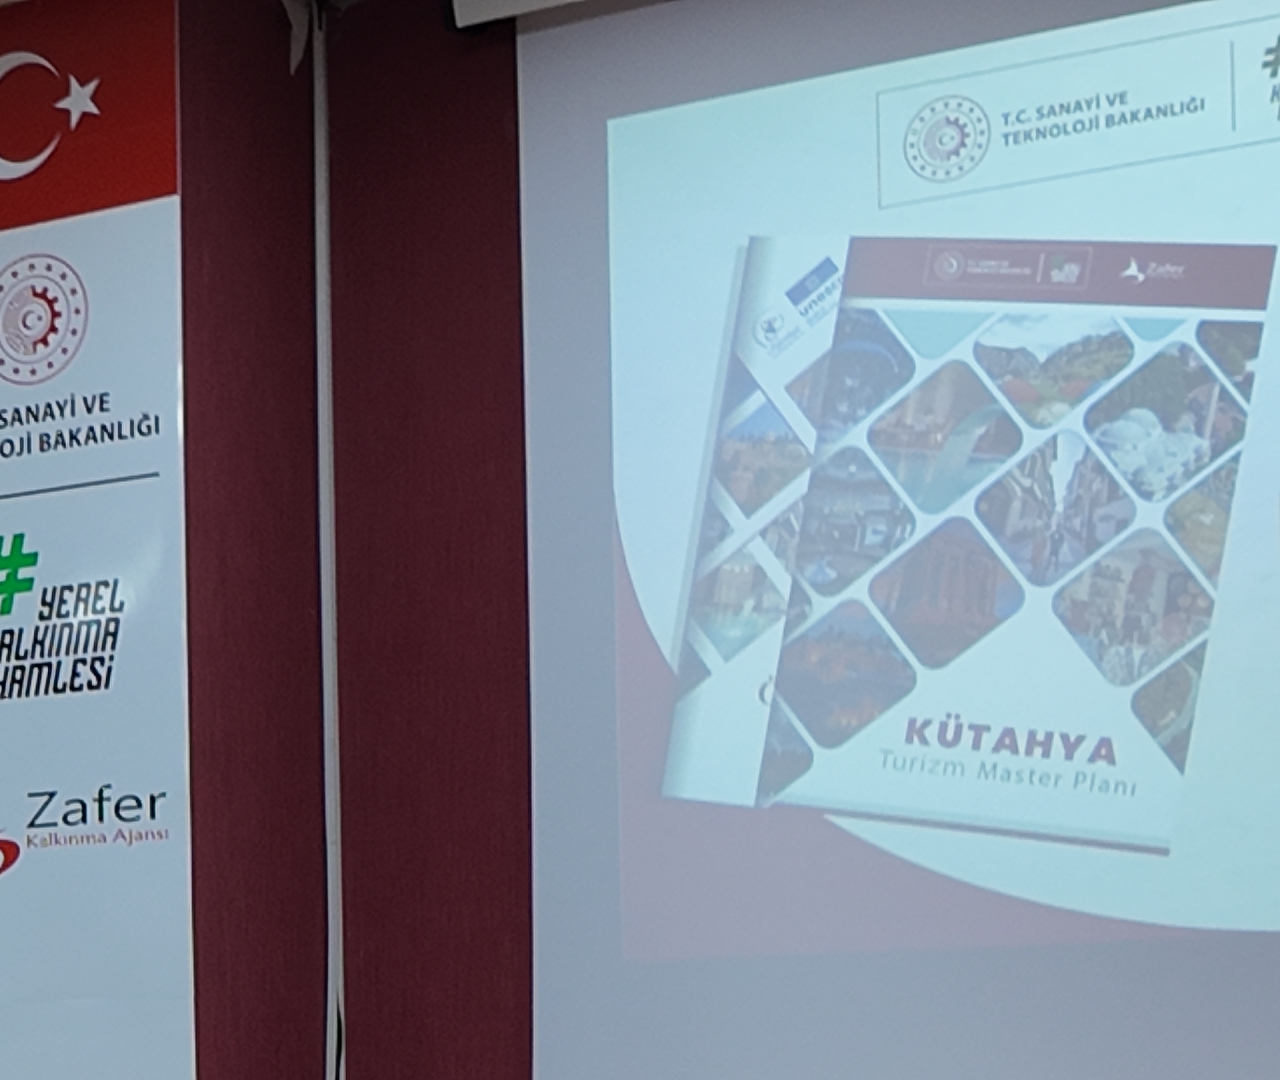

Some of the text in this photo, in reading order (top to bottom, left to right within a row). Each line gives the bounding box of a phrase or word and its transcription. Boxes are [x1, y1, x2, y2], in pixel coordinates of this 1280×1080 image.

[1001, 90, 1128, 127] T.C. SANAYİ VE
[1001, 95, 1206, 147] TEKNOLOJİ BAKANLIĞI
[82, 391, 111, 415] VE
[39, 412, 160, 453] BAKANLIĞI
[904, 712, 1117, 767] KÜTAHYA
[880, 749, 1138, 797] Turizm Master Planı
[26, 783, 167, 829] Zafer
[112, 827, 170, 847] Ajansı
